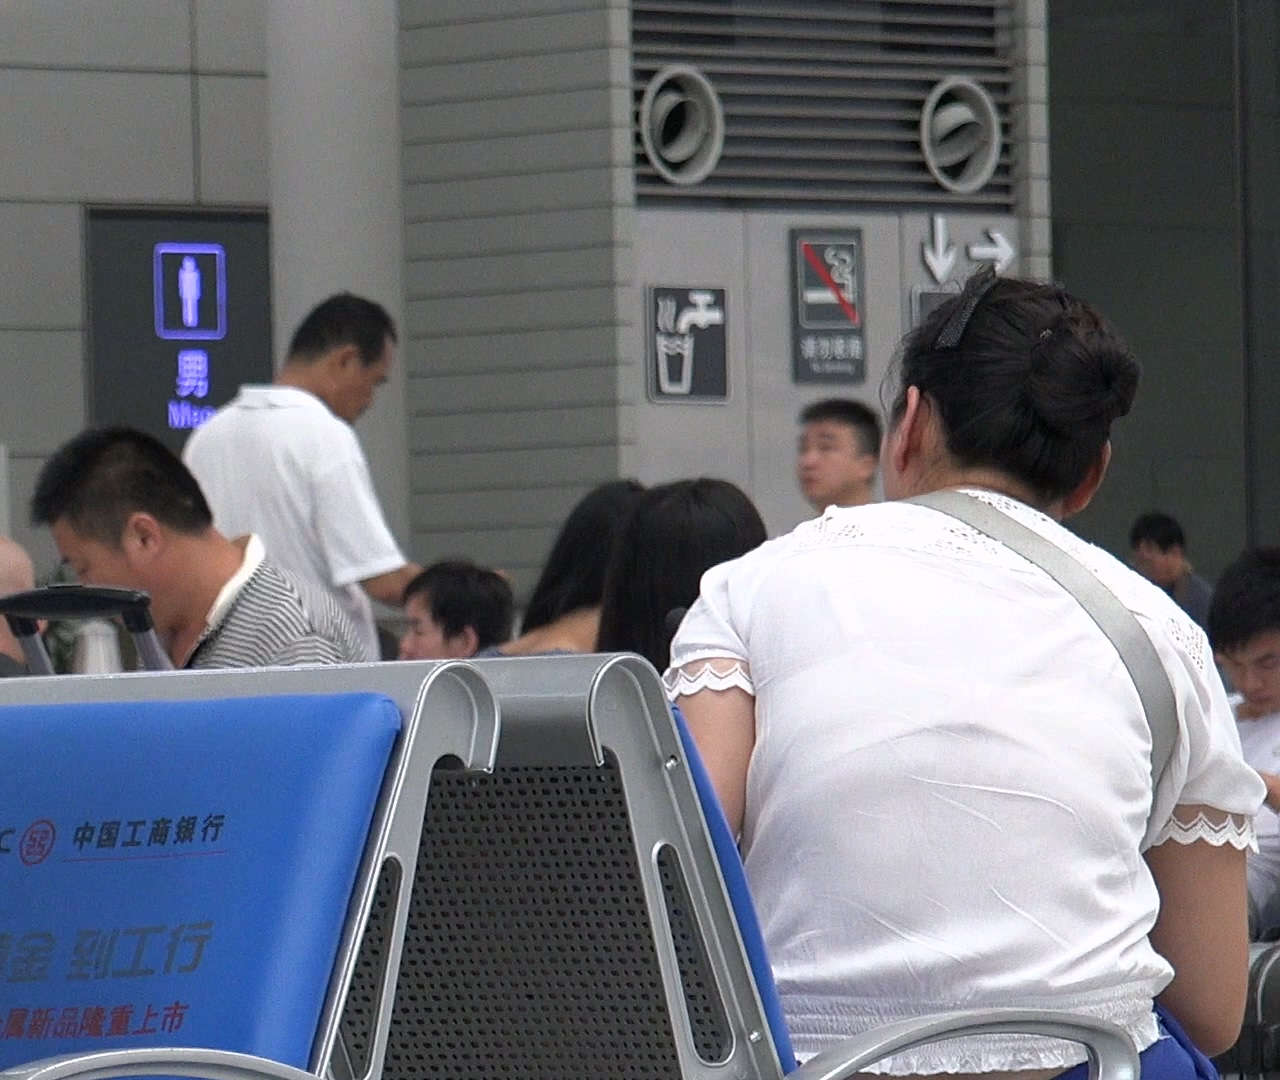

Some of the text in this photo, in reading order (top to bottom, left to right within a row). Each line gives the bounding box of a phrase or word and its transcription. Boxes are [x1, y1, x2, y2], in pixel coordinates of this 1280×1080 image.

[175, 349, 209, 398] 男
[73, 814, 225, 851] 中国工商银行
[67, 921, 214, 981] 到工行
